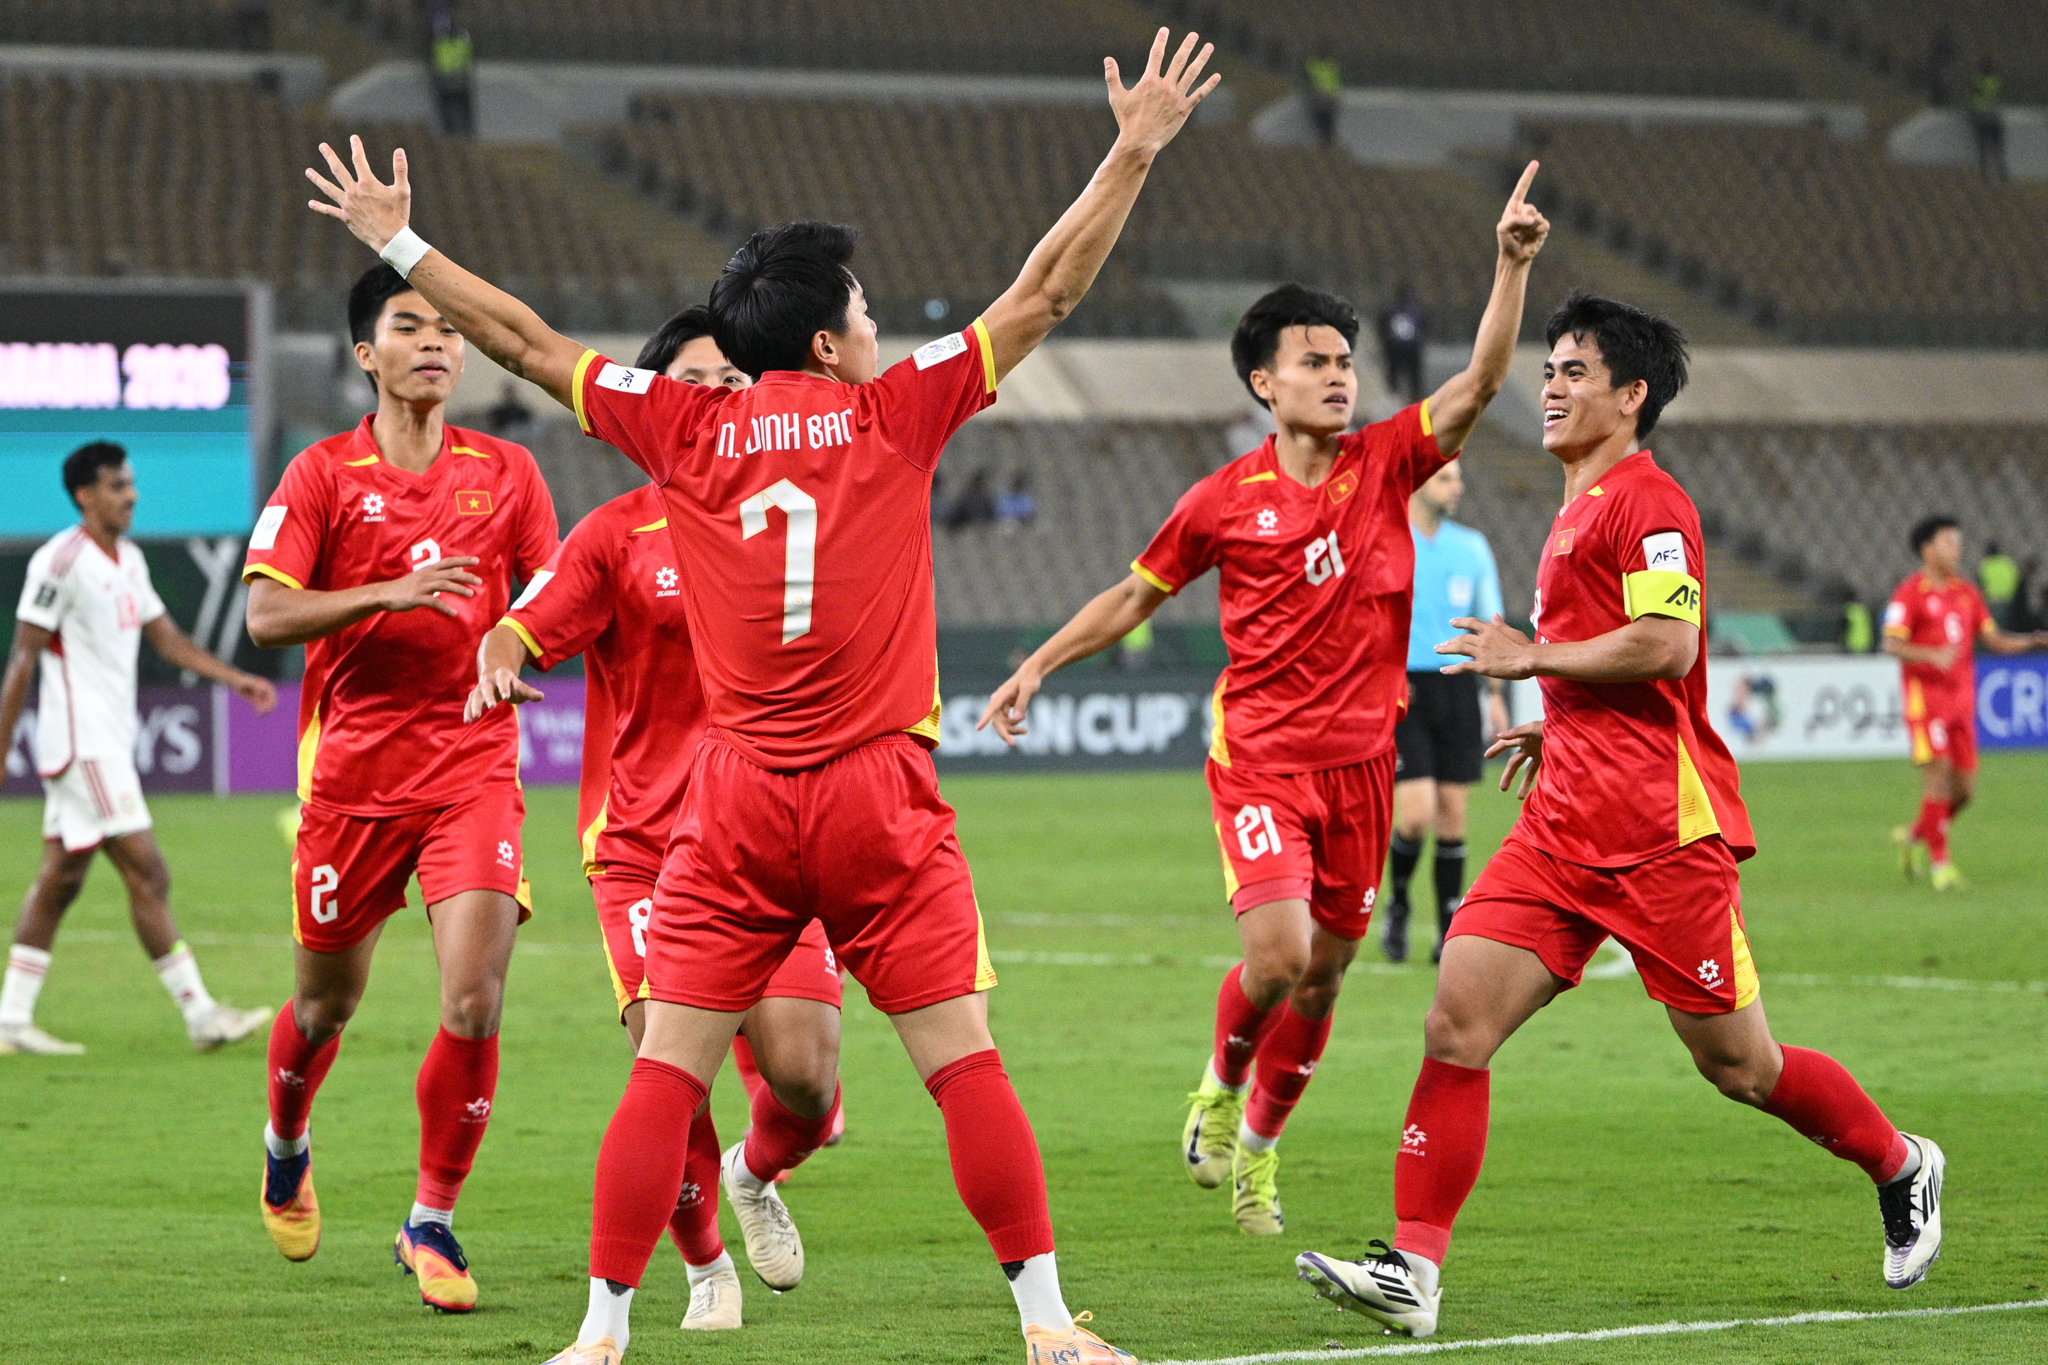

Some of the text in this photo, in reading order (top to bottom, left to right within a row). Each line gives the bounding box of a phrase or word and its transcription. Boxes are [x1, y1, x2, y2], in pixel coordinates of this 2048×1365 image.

[739, 478, 817, 645] 7
[1304, 529, 1346, 587] 21
[1652, 549, 1679, 564] AFC
[1077, 692, 1190, 756] CUP
[1977, 668, 2048, 738] CR
[1234, 804, 1283, 861] 21
[311, 864, 339, 925] 2
